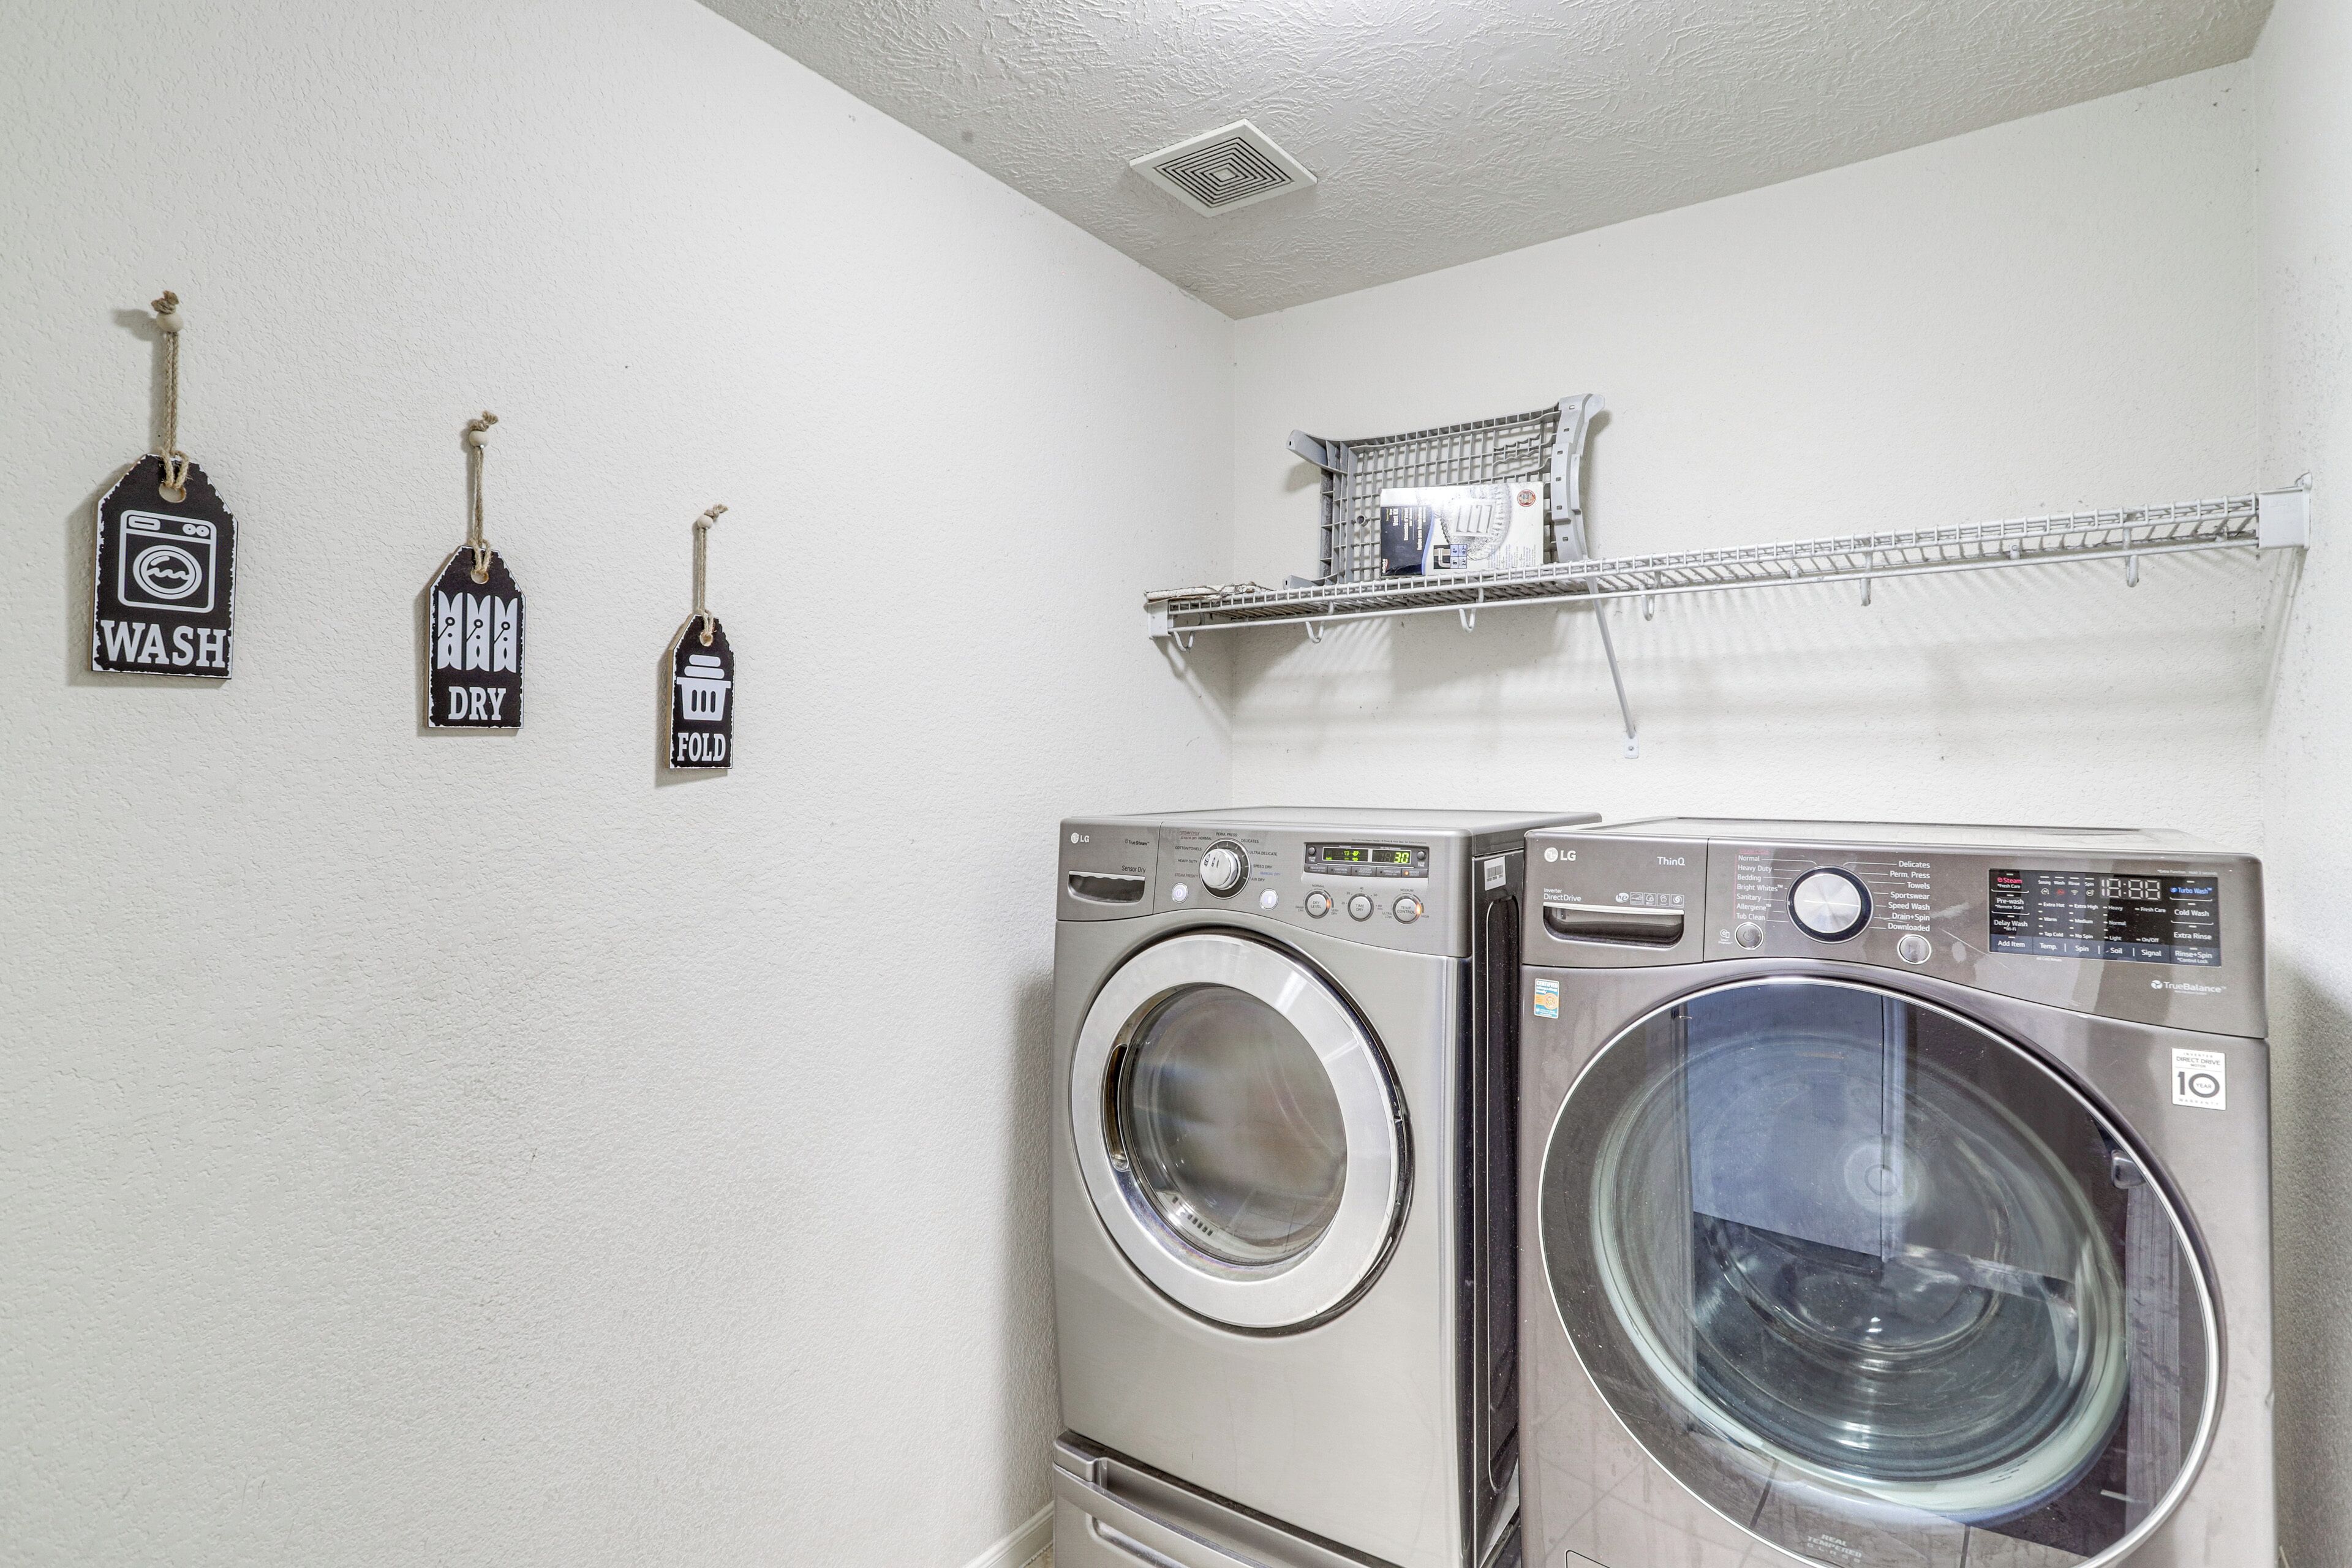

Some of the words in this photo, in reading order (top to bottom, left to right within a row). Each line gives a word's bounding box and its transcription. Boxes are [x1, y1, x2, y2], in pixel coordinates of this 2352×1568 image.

[100, 620, 227, 668] WASH
[448, 686, 506, 720] DRY
[677, 732, 726, 761] FOLD
[1394, 852, 1409, 864] 30
[1560, 850, 1577, 861] LG
[1657, 856, 1686, 866] ThinQ
[1736, 894, 1762, 902] Sanitary
[1890, 891, 1931, 900] Sportswear
[1888, 902, 1910, 910] Speed
[1892, 912, 1930, 922] Drain+Spin
[1888, 922, 1930, 932] Downloaded
[2174, 950, 2212, 959] Rinse+Spin
[2177, 1071, 2220, 1098] 10
[1821, 1534, 1848, 1547] REAL
[1807, 1536, 1862, 1558] TEMPERED
